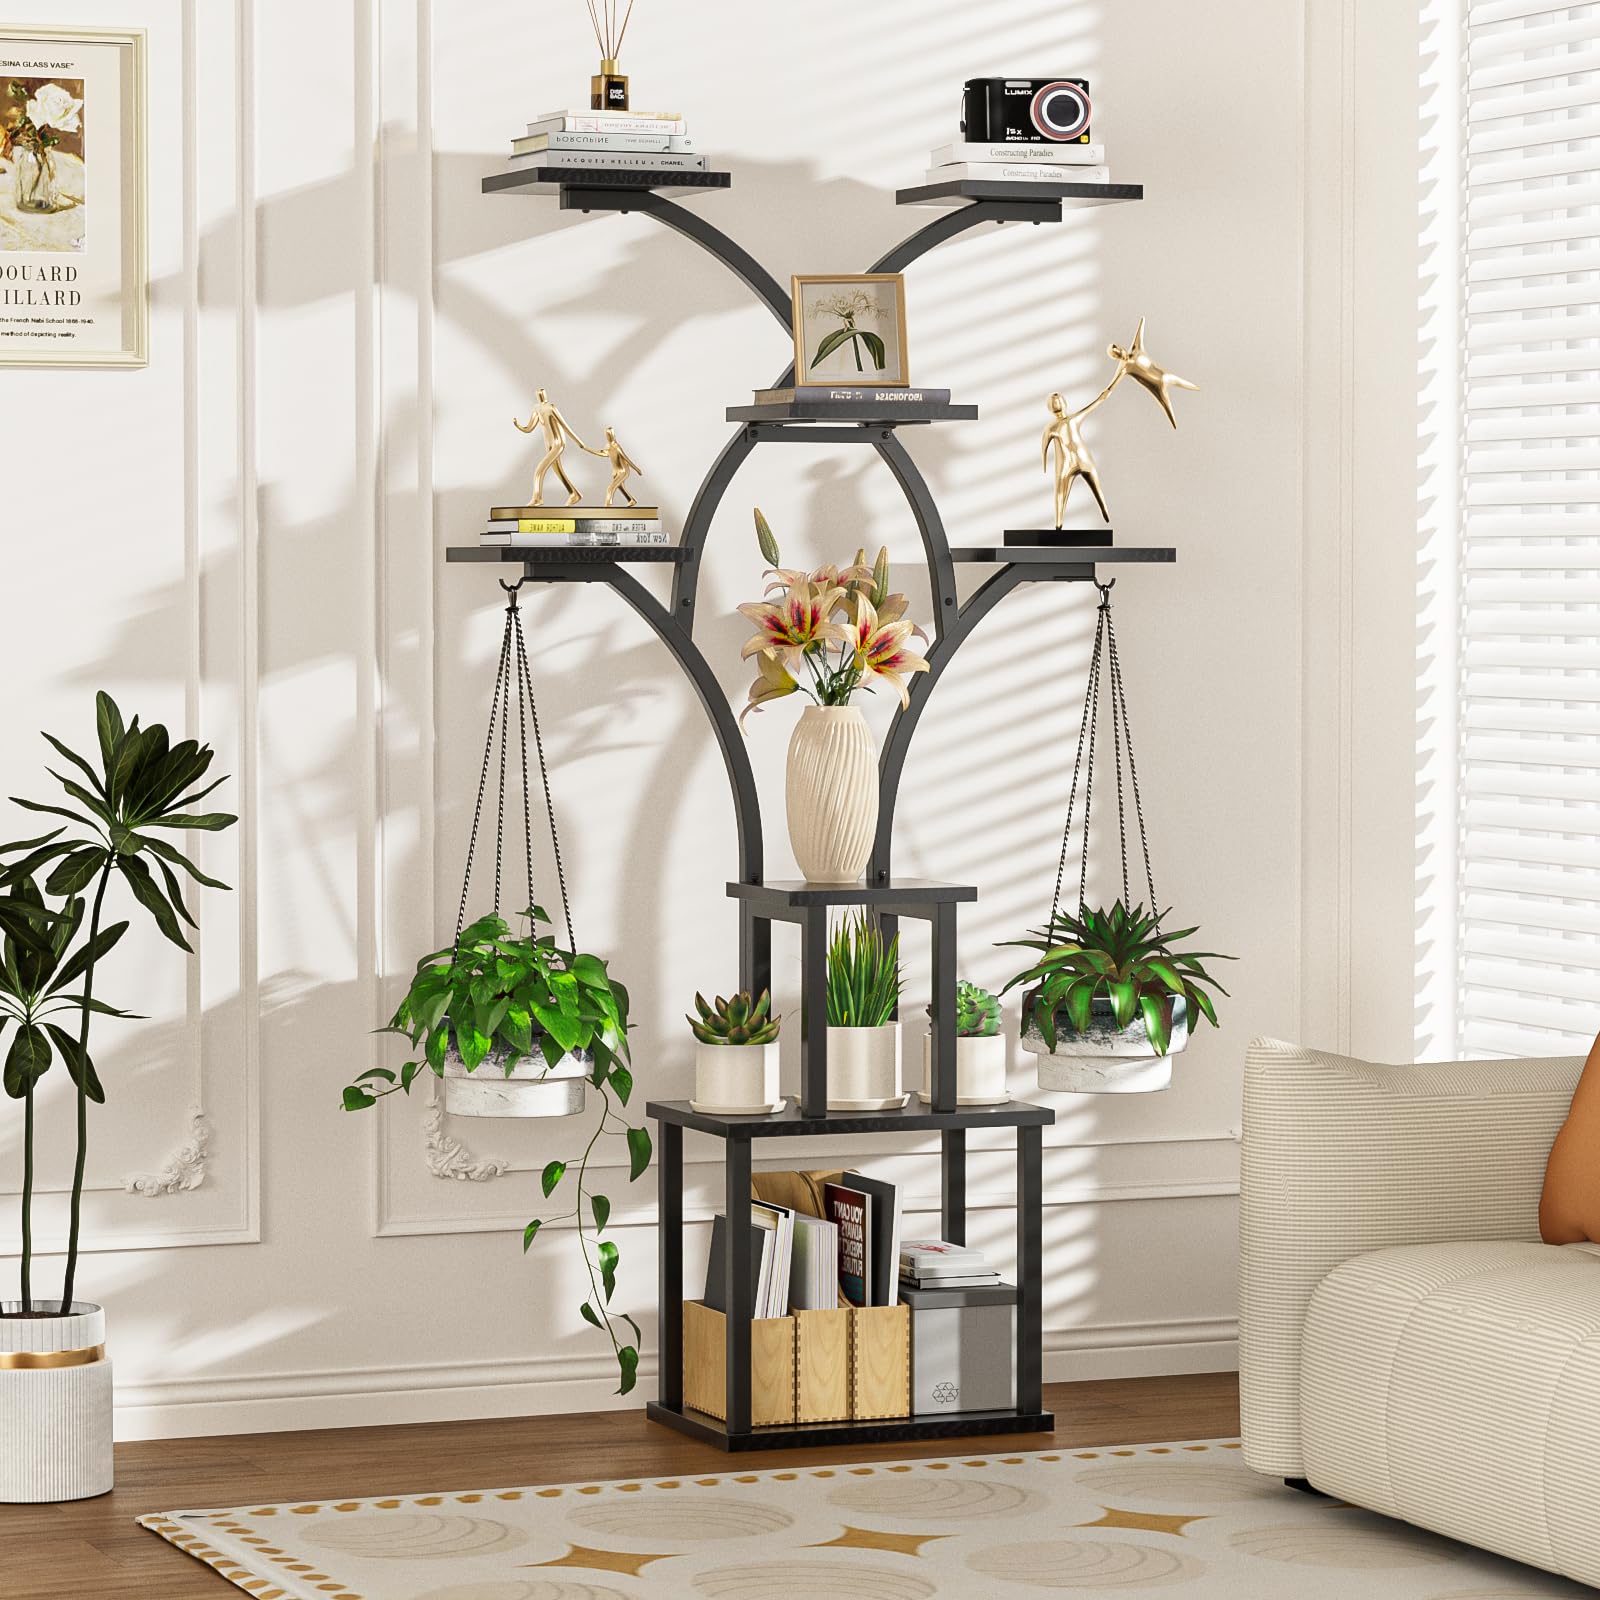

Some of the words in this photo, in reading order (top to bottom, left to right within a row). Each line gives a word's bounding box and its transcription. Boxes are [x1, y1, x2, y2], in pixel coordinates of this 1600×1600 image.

[1004, 88, 1033, 96] LUMIX
[990, 148, 1028, 158] Constructing
[1002, 168, 1039, 179] Constructing
[4, 289, 81, 306] ILLARD
